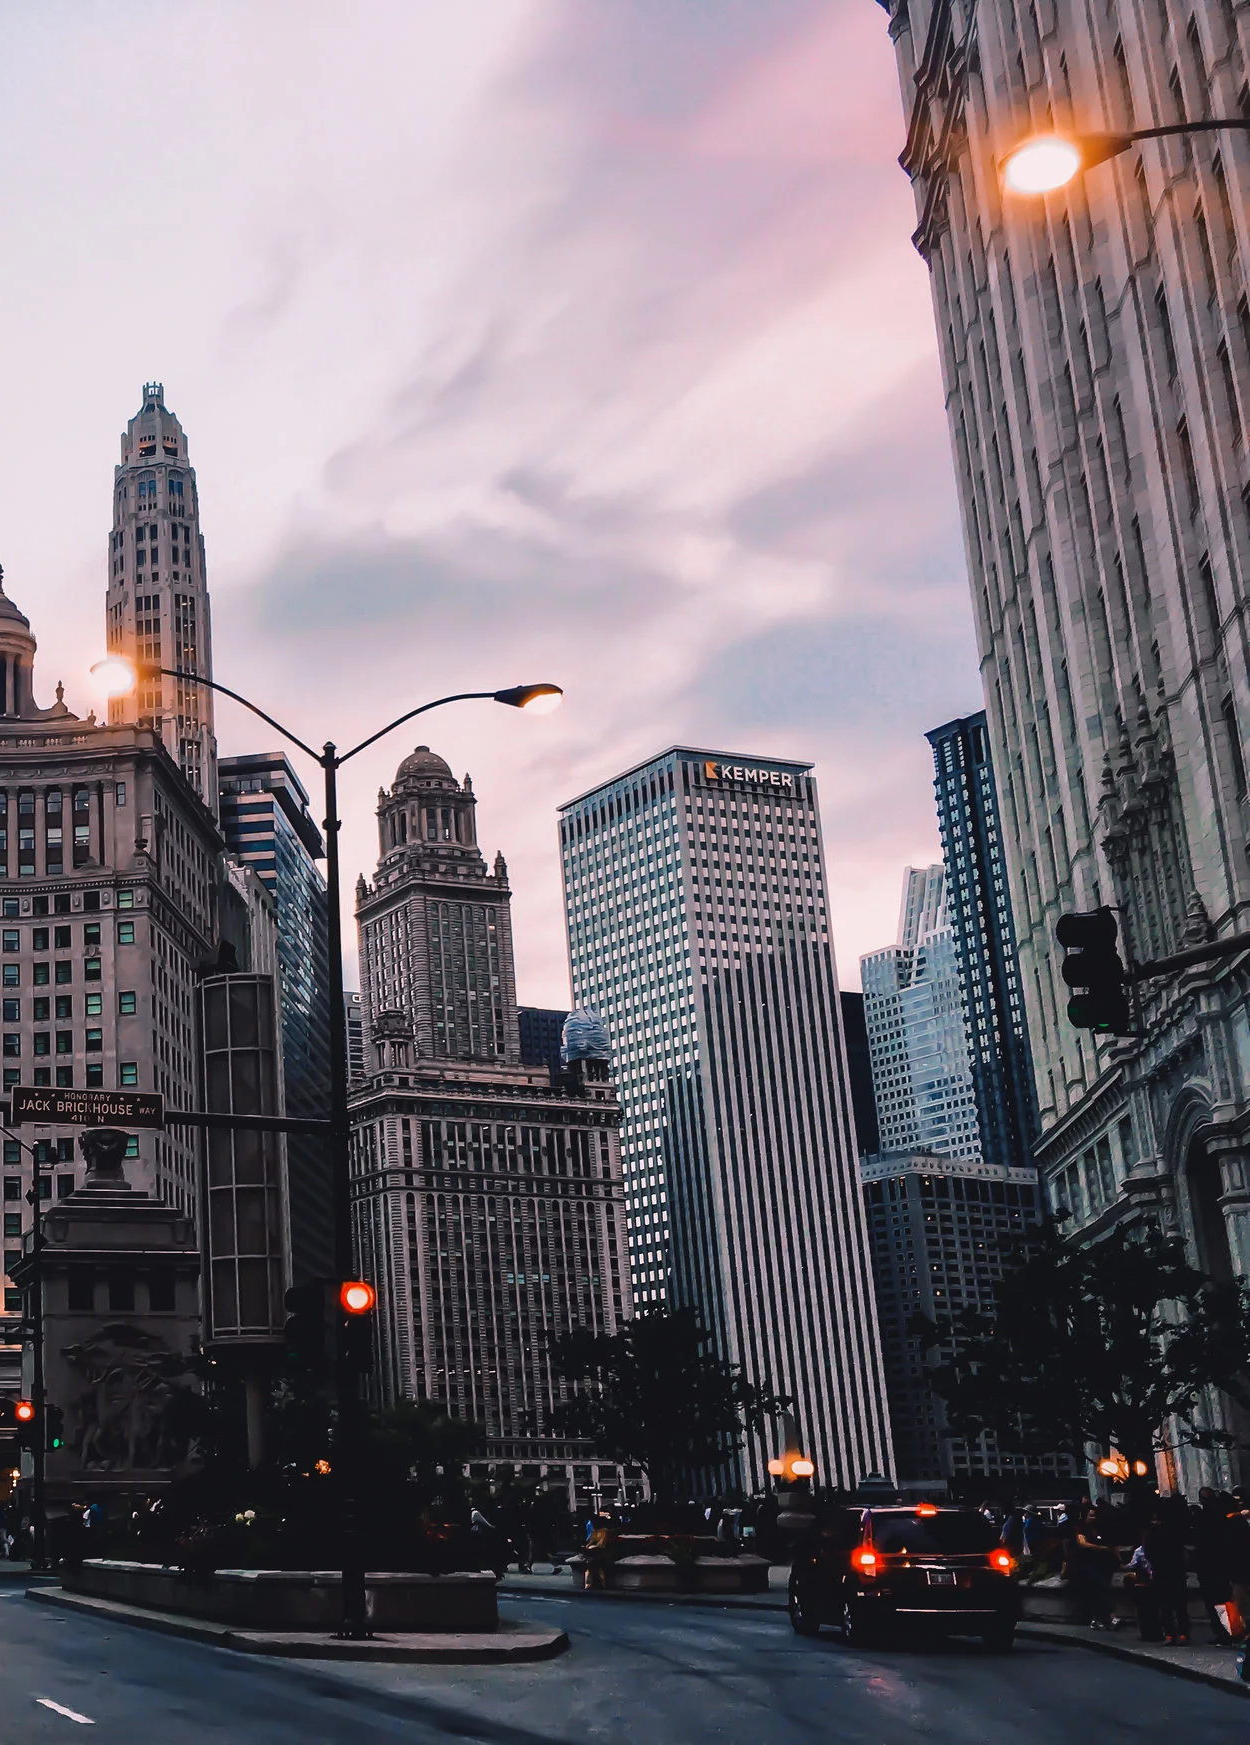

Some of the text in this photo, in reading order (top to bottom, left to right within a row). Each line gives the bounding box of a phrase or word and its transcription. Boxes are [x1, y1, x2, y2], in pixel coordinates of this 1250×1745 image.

[721, 765, 792, 787] KEMPER
[64, 1092, 111, 1102] HONORARY
[19, 1099, 156, 1115] JACK BRICKHOUSE WAY
[97, 1115, 105, 1123] N
